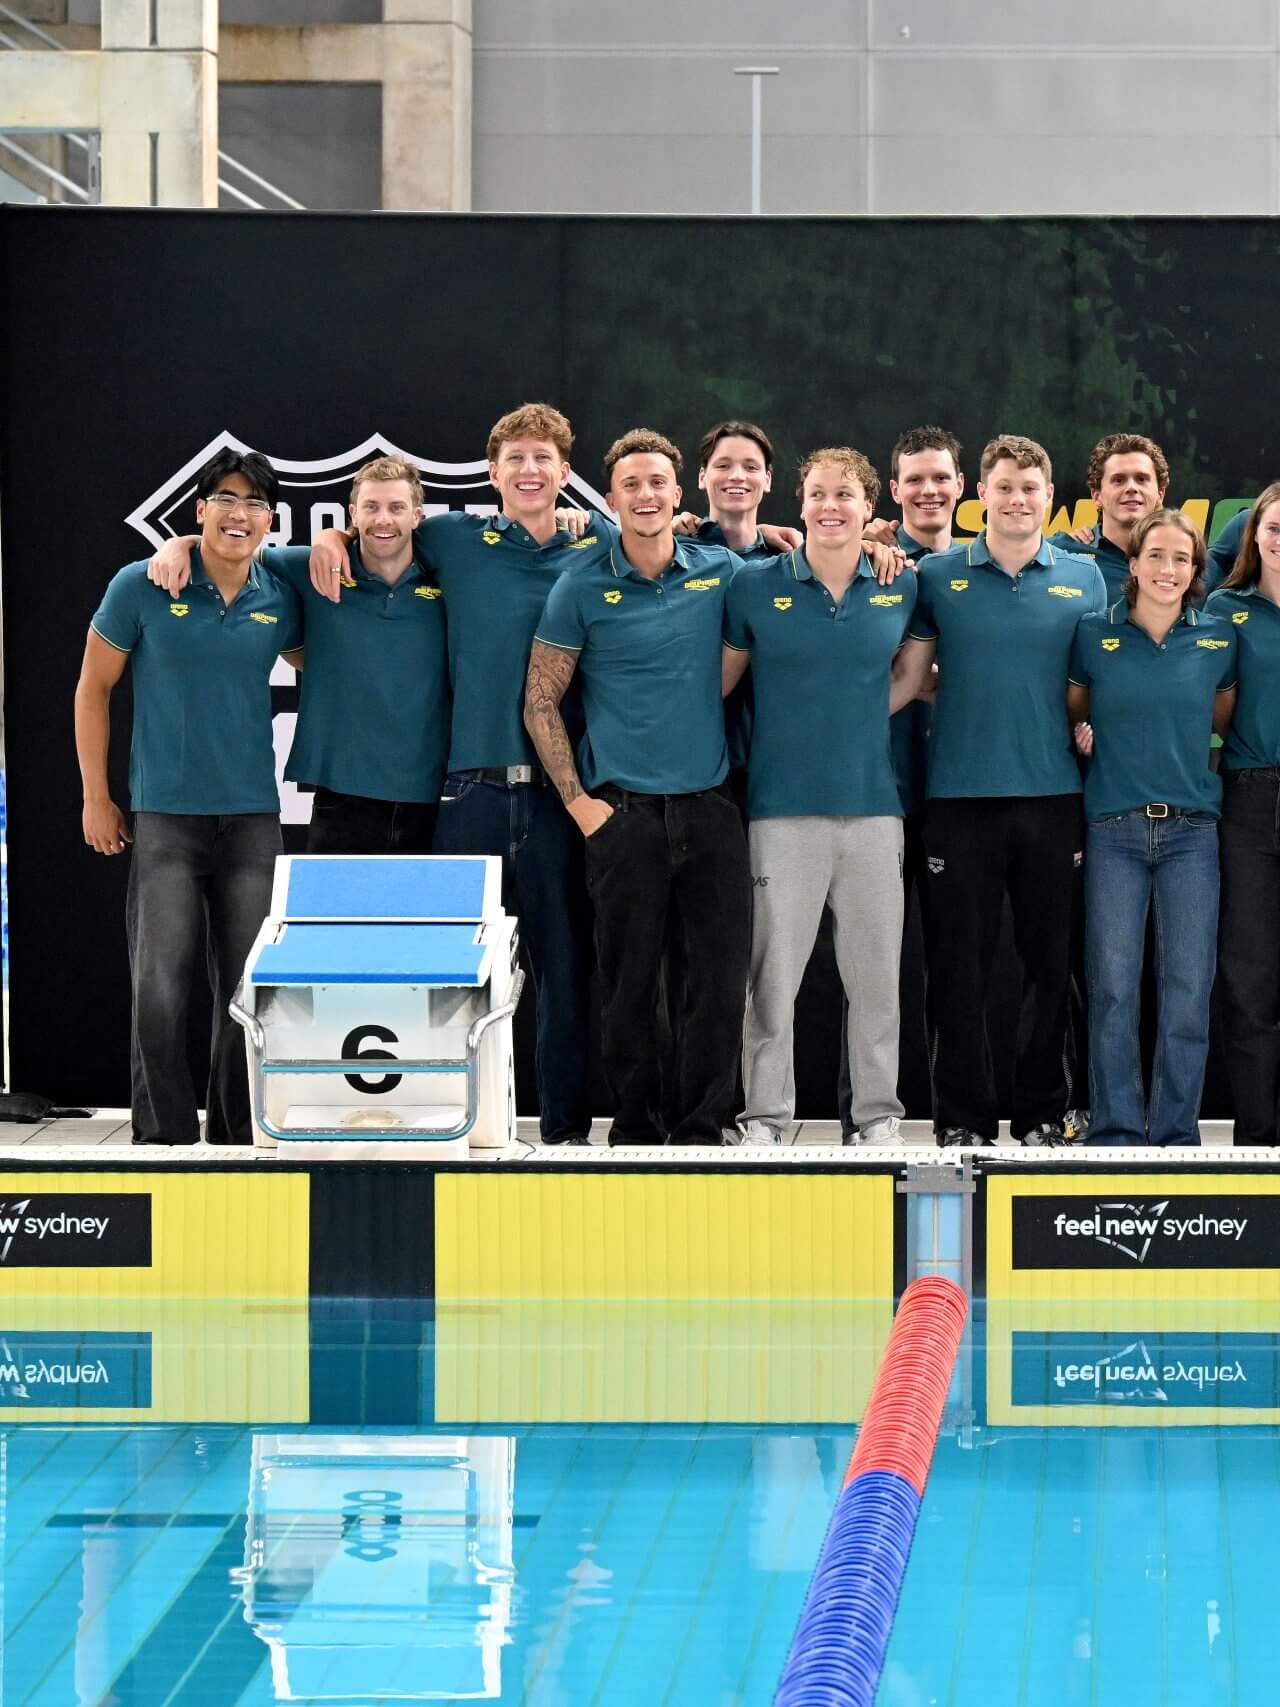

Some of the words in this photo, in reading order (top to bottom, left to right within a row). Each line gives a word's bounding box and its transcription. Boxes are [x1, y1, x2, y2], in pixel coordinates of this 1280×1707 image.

[341, 1025, 403, 1094] 6
[24, 1212, 109, 1239] sydney
[1054, 1214, 1100, 1236] feel
[1105, 1219, 1159, 1236] new
[1163, 1214, 1248, 1241] sydney
